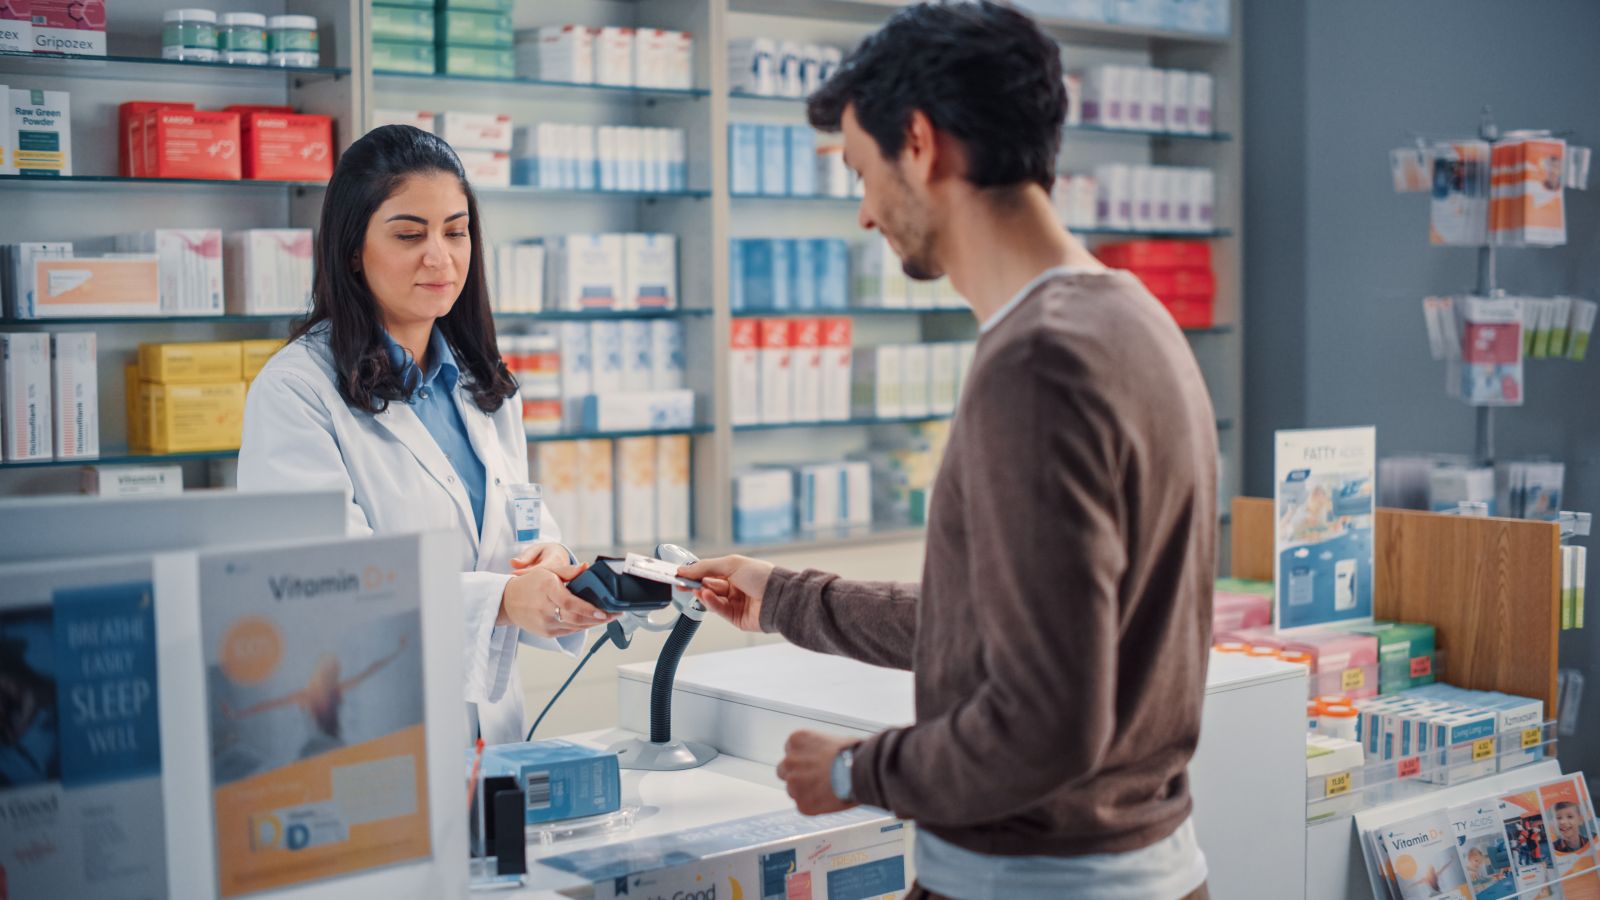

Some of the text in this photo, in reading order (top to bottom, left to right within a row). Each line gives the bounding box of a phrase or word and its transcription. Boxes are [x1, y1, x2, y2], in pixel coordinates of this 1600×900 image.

[35, 34, 94, 50] Gripozex
[15, 107, 62, 118] Raw Green
[22, 116, 55, 127] Powder
[1304, 446, 1336, 461] FATTY
[118, 473, 157, 485] Vitamin
[266, 568, 360, 602] Vitamin
[67, 616, 146, 649] BREATHE
[71, 677, 151, 726] SLEEP
[87, 723, 138, 755] WELL
[1391, 831, 1430, 850] Vitamin
